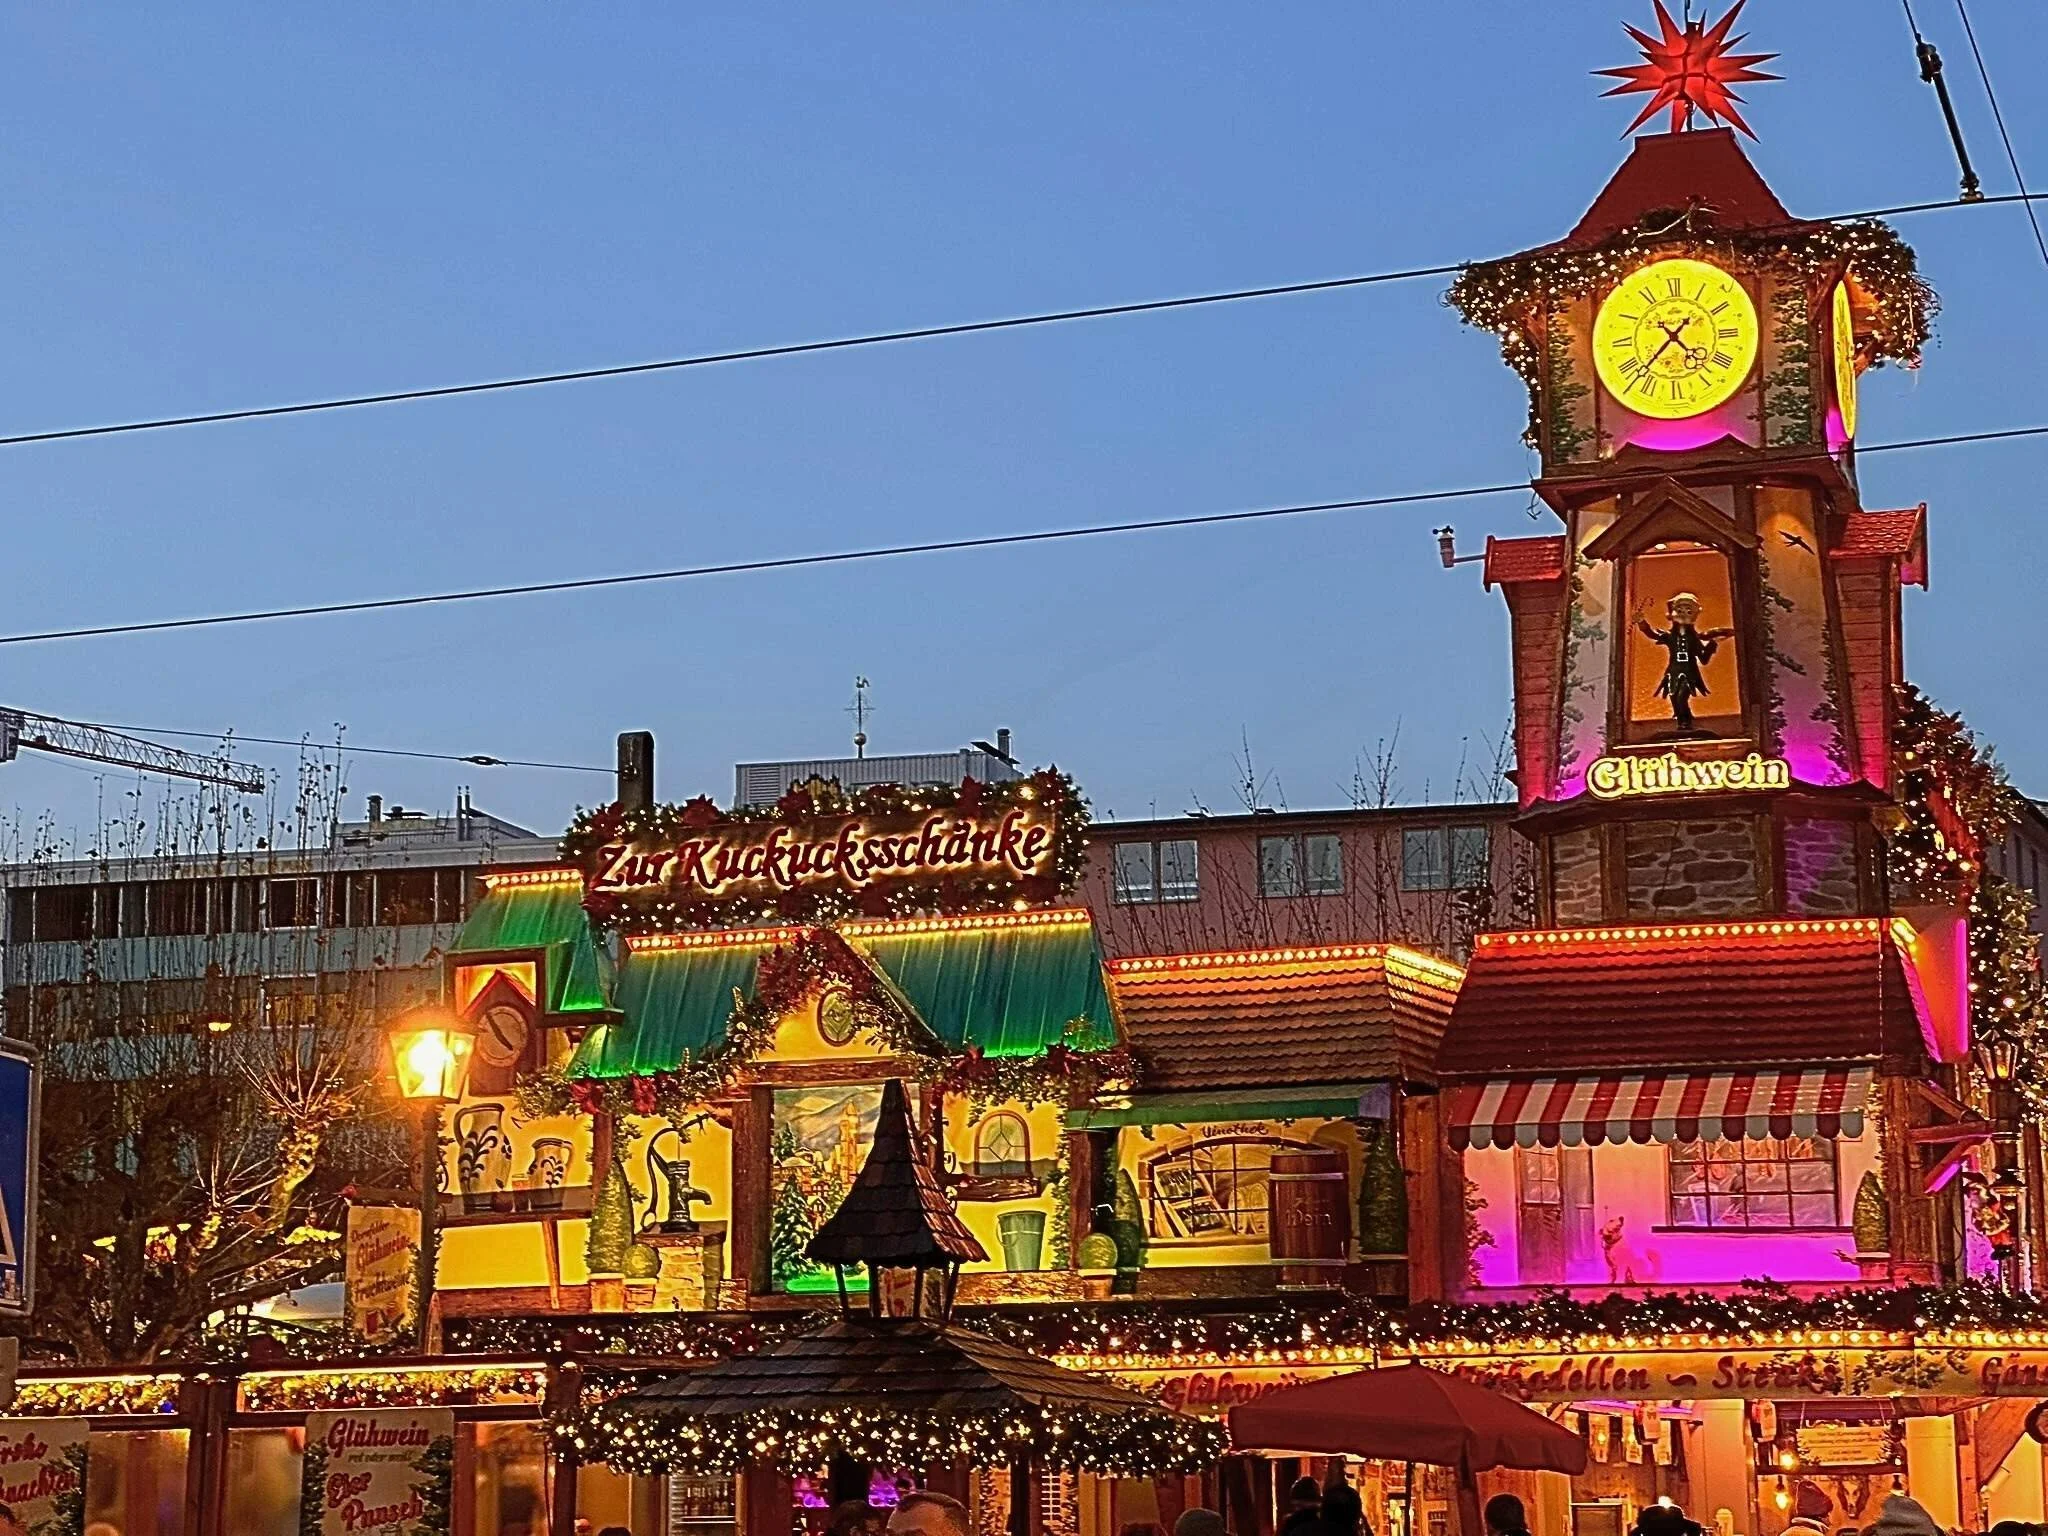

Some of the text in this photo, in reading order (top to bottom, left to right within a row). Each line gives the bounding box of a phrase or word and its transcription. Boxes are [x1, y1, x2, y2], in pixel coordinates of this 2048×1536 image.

[1588, 753, 1789, 798] Glühwein
[595, 810, 1048, 892] Zur Kuckucksschänke
[327, 1417, 430, 1458] Glühwein
